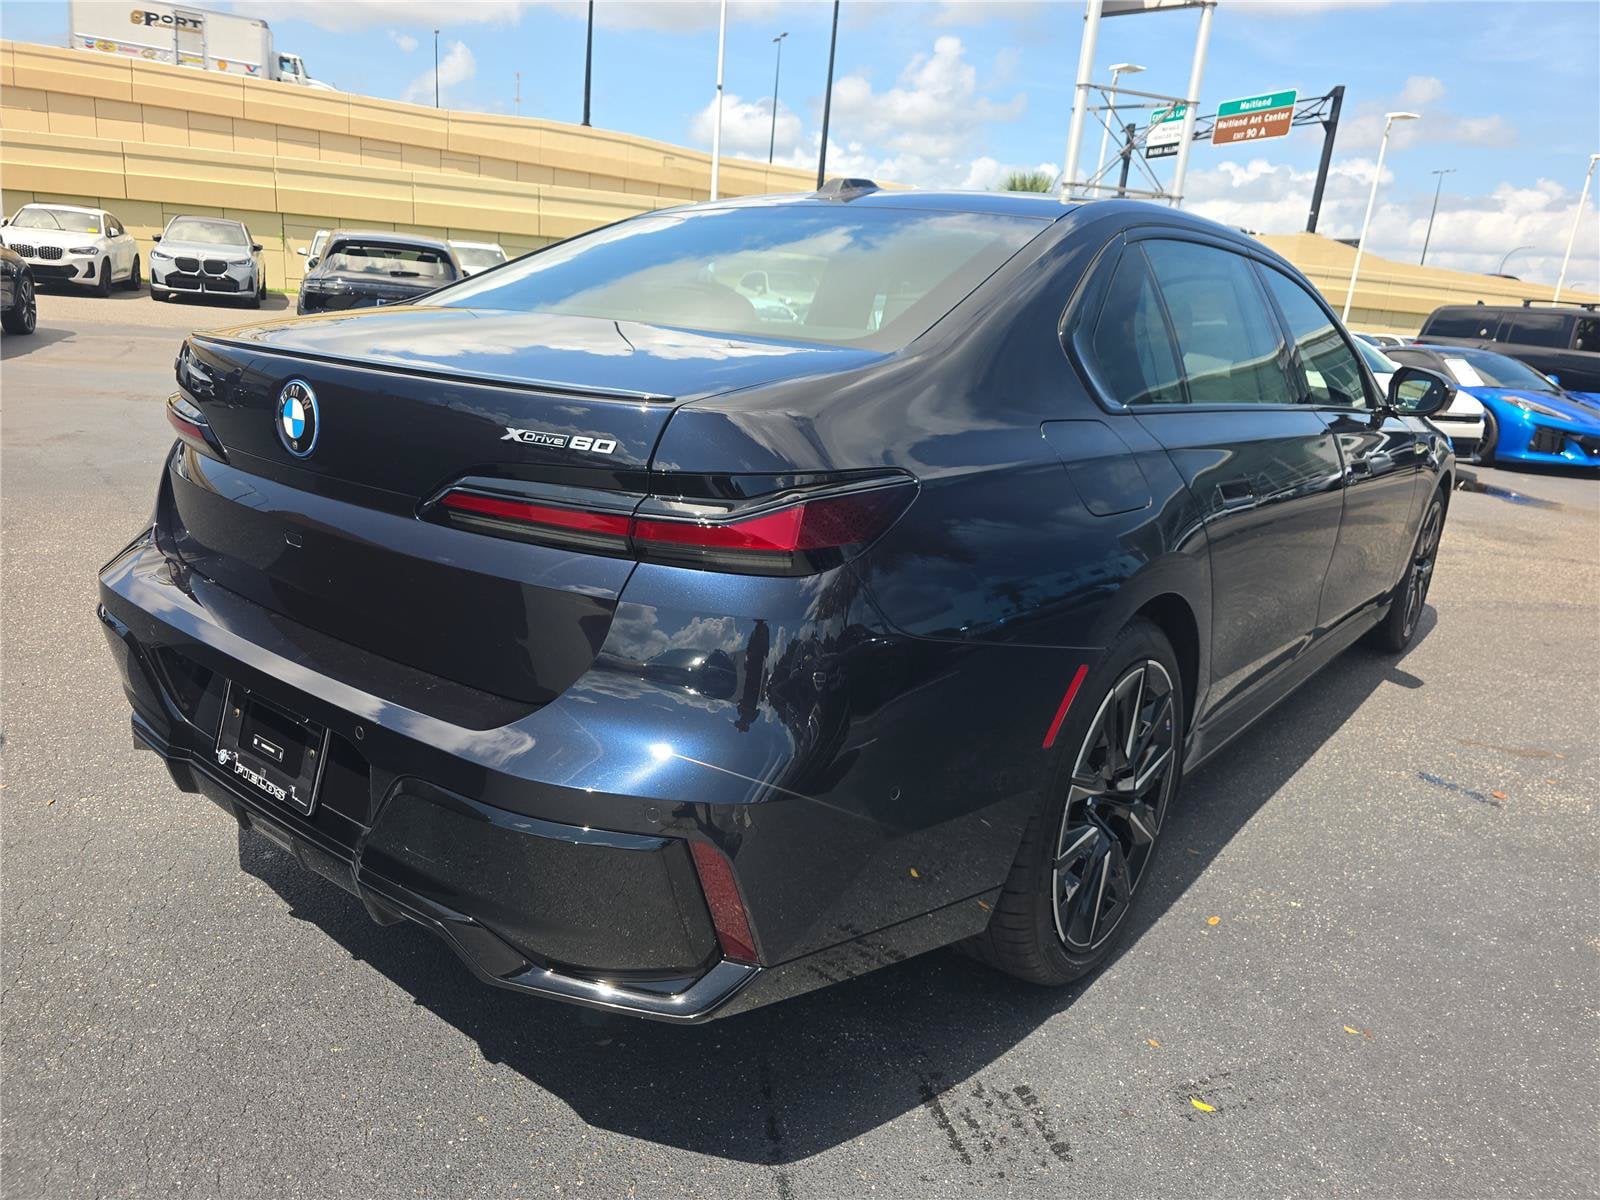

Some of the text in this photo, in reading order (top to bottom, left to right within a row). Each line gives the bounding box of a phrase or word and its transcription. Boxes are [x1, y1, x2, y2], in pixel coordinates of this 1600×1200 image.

[1240, 97, 1272, 110] Maitland
[1217, 112, 1290, 129] Maitland Art Center
[1246, 127, 1257, 138] 90
[1259, 126, 1266, 136] A
[569, 436, 617, 454] 60
[235, 761, 287, 800] FIELDS
